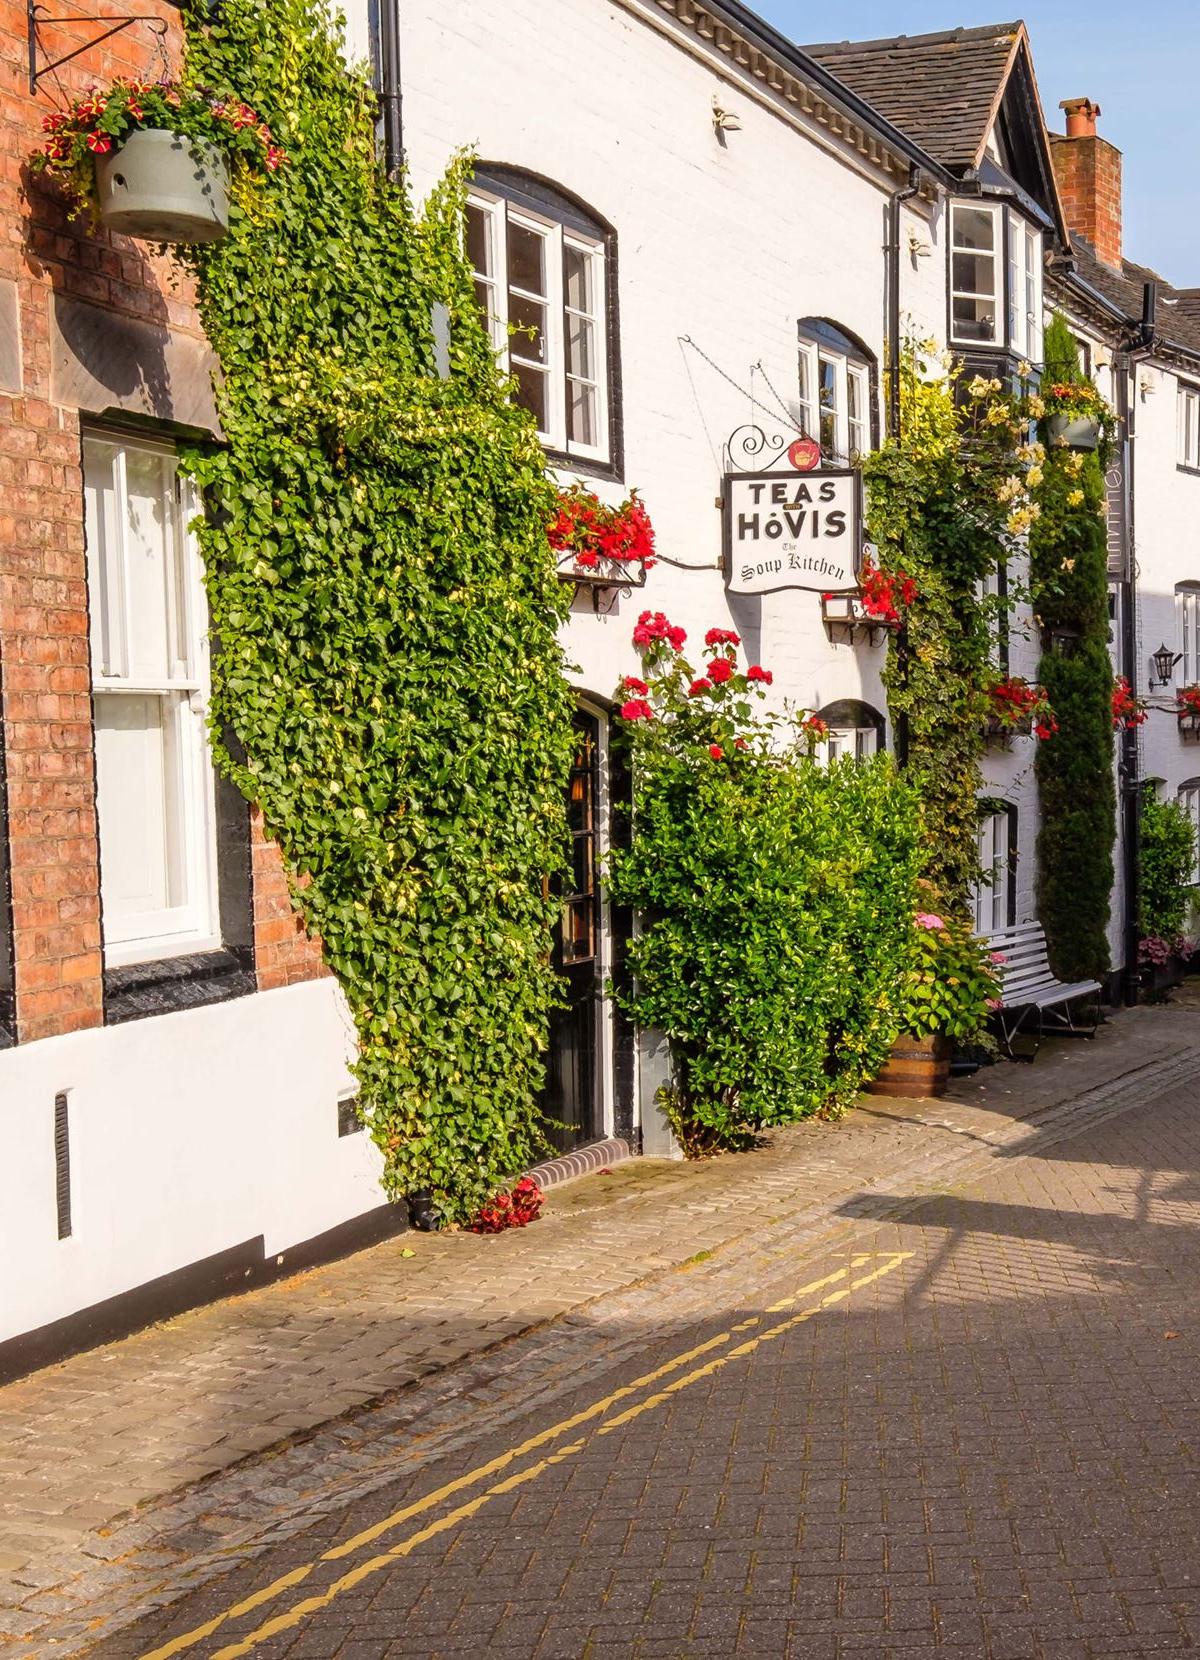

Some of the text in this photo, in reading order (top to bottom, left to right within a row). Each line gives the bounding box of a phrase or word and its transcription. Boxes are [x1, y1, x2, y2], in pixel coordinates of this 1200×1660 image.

[749, 481, 836, 504] TEAS
[741, 553, 845, 582] Soup Kitchen
